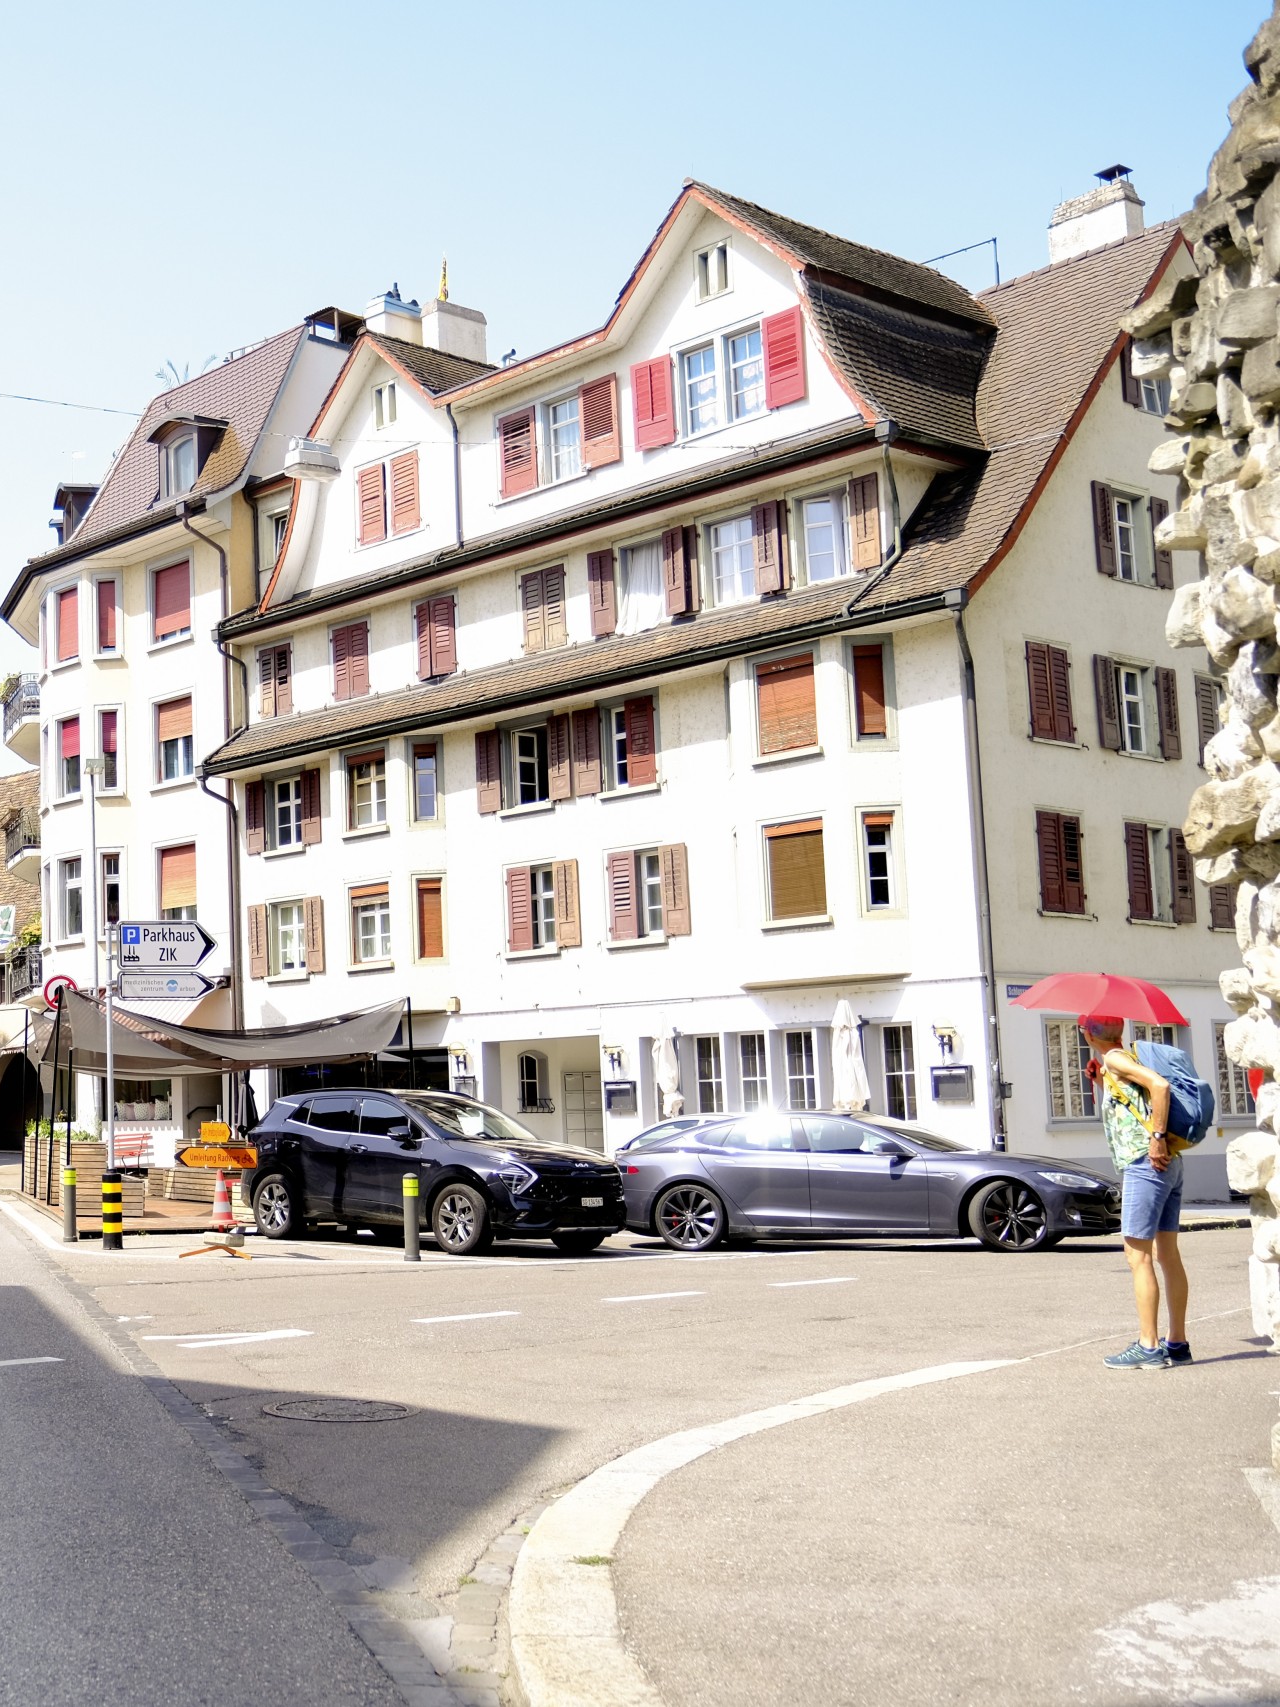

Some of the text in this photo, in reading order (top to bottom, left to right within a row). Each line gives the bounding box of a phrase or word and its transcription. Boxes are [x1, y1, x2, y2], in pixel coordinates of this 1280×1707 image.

[143, 927, 195, 942] Parkhaus
[159, 948, 178, 961] ZIK
[190, 1154, 217, 1164] Umleitung
